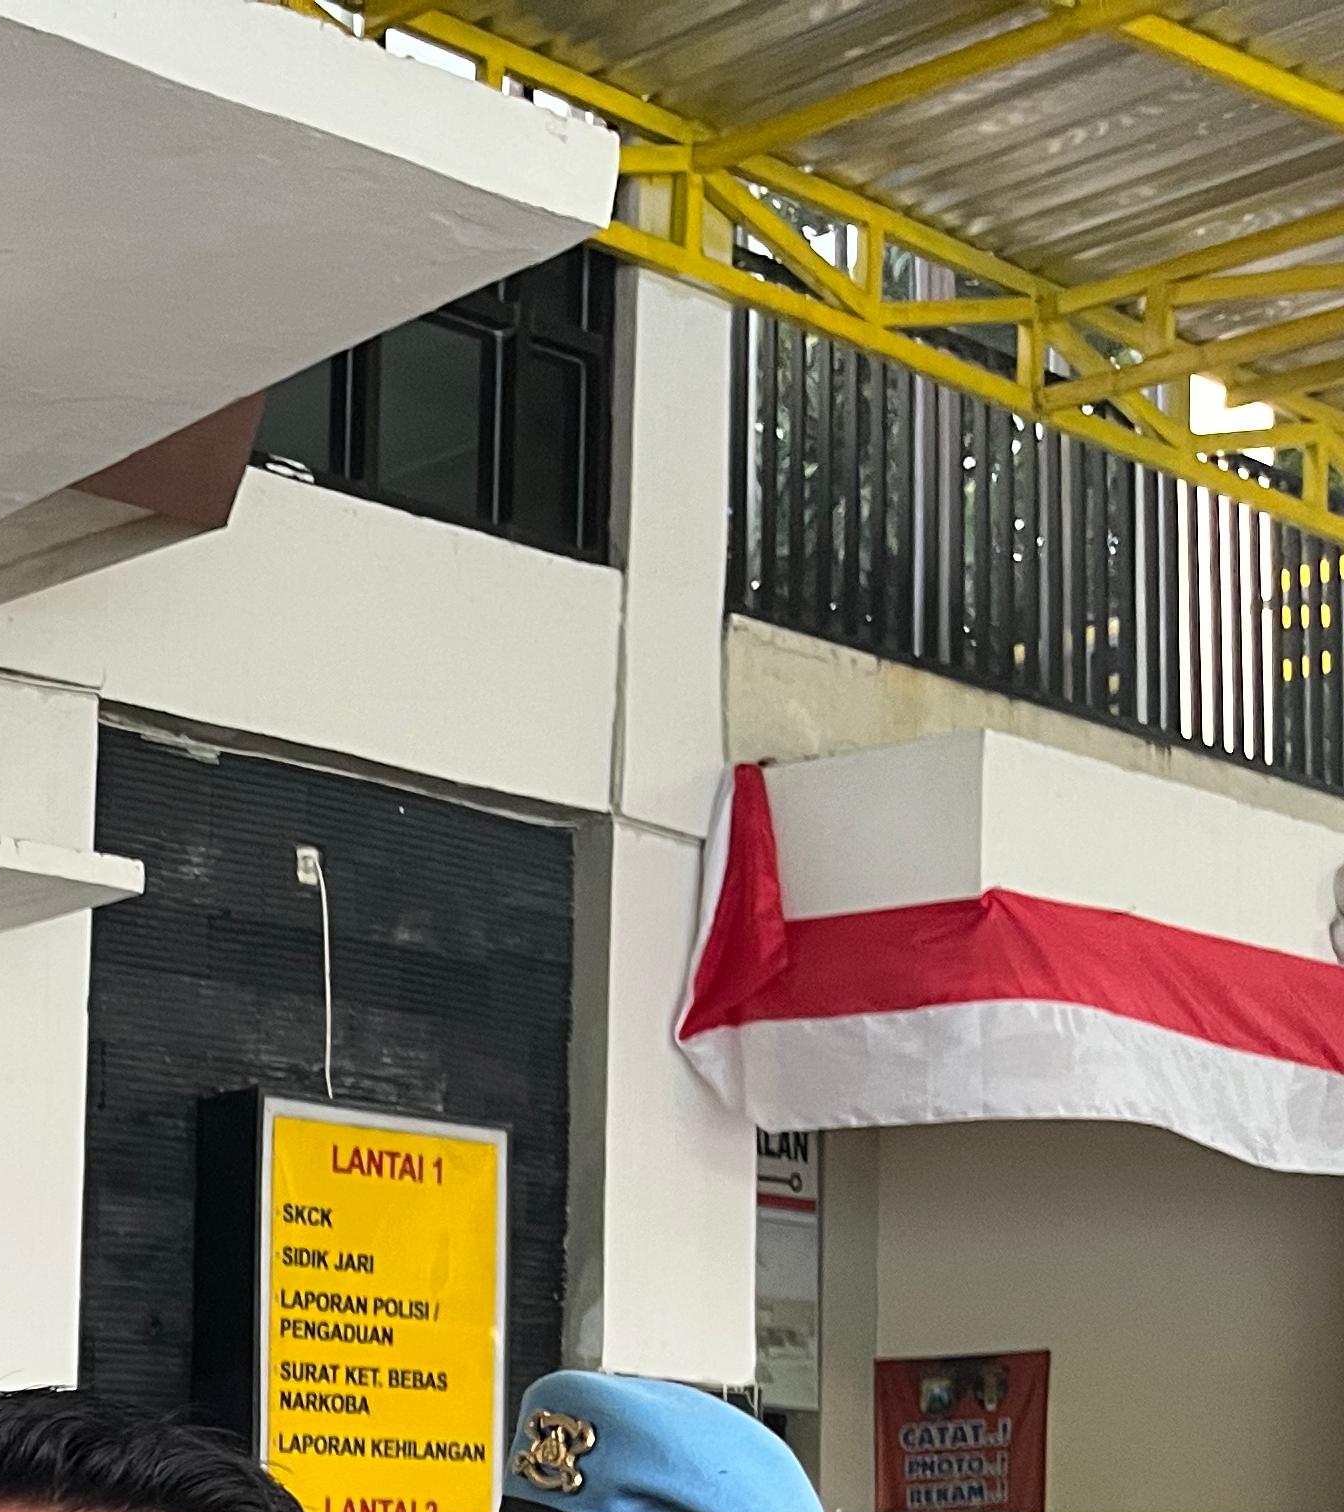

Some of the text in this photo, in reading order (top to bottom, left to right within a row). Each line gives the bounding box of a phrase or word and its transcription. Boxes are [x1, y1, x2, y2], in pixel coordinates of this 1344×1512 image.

[332, 1145, 443, 1185] LANTAI 1
[282, 1203, 333, 1228] SKCK
[282, 1246, 374, 1274] SIDIK JARI
[280, 1289, 368, 1316] LAPORAN
[373, 1297, 430, 1321] POLISI
[280, 1319, 394, 1345] PENGADUAN
[280, 1362, 448, 1391] SURAT KET. BEBAS
[280, 1391, 370, 1416] NARKOBA
[279, 1433, 486, 1463] LAPORAN KEHILANGAN
